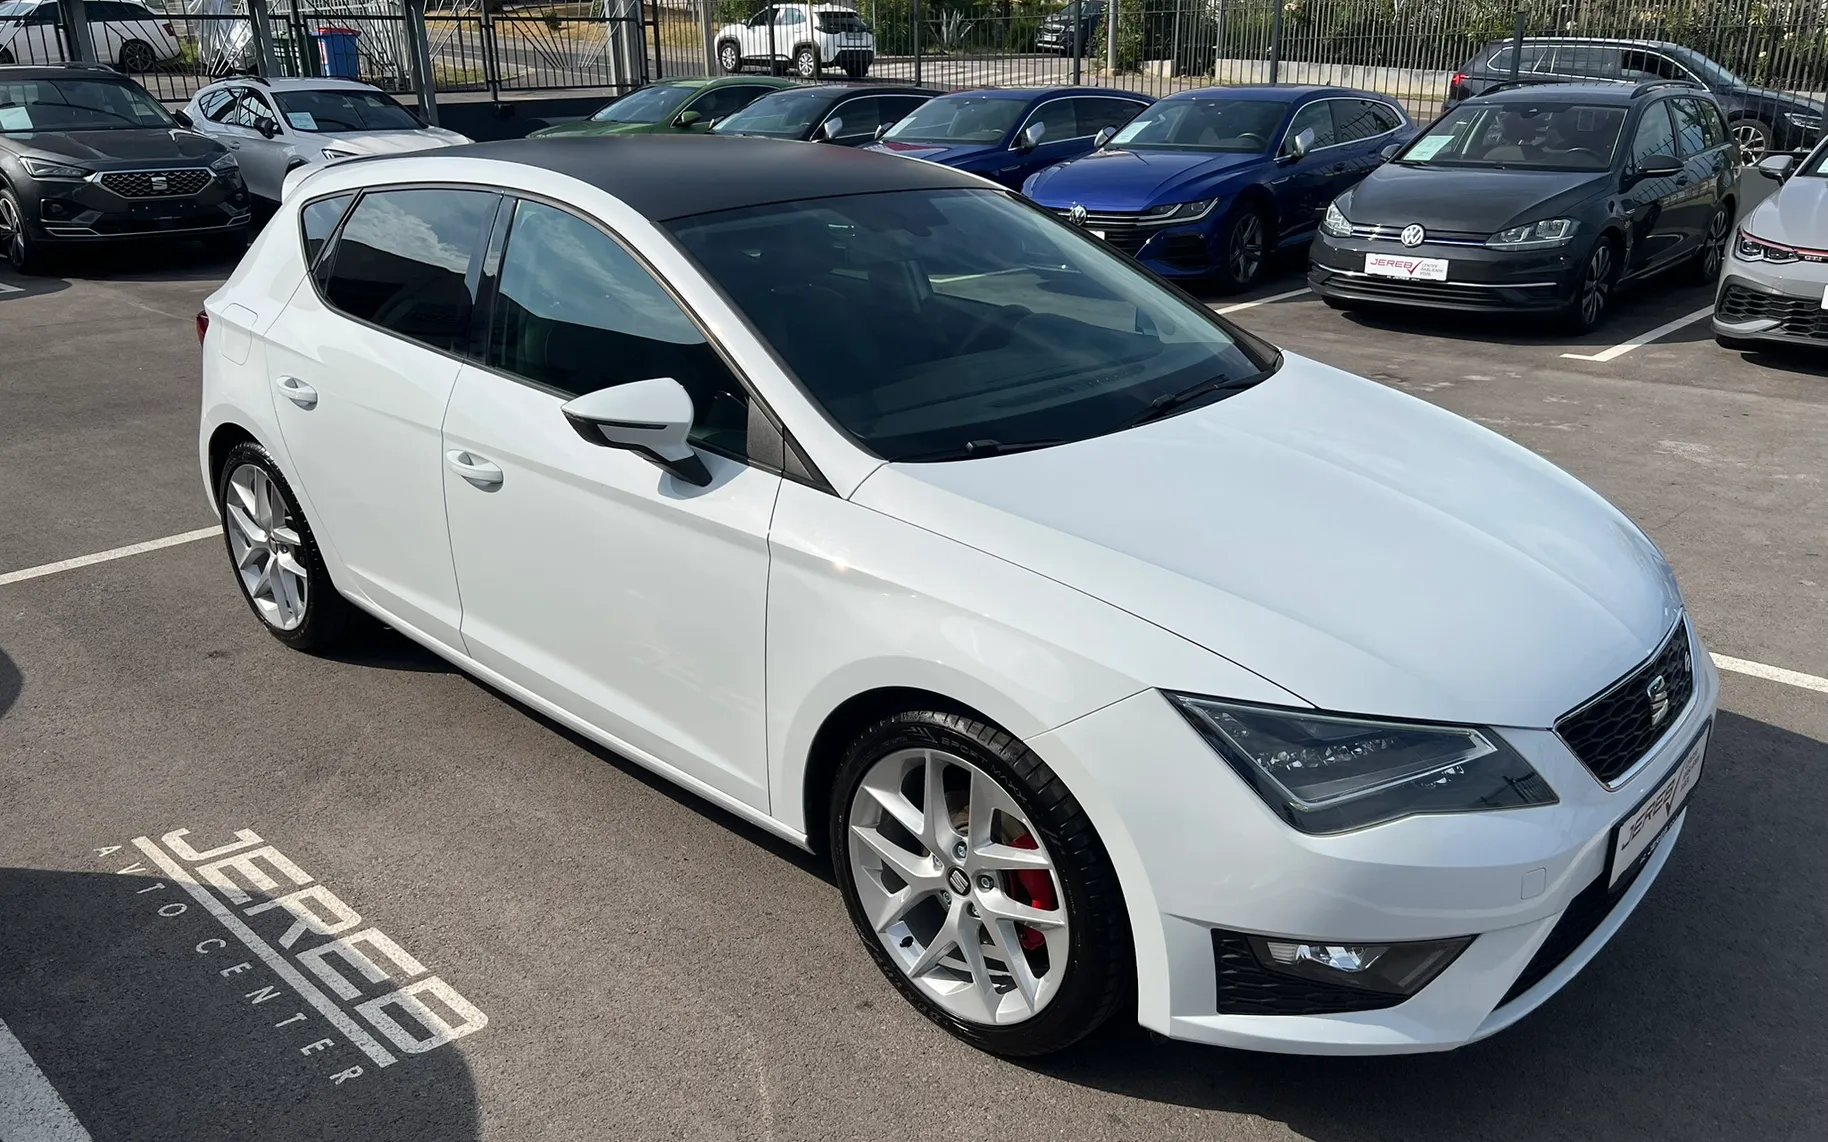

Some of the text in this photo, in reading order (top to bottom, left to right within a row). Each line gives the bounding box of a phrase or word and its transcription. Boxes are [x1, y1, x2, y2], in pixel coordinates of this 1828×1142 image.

[1370, 258, 1413, 269] JEREB
[940, 737, 988, 764] SPORT
[1621, 778, 1675, 851] JEREB
[93, 844, 364, 1085] AVTO CENTER
[162, 828, 488, 1053] JEREB
